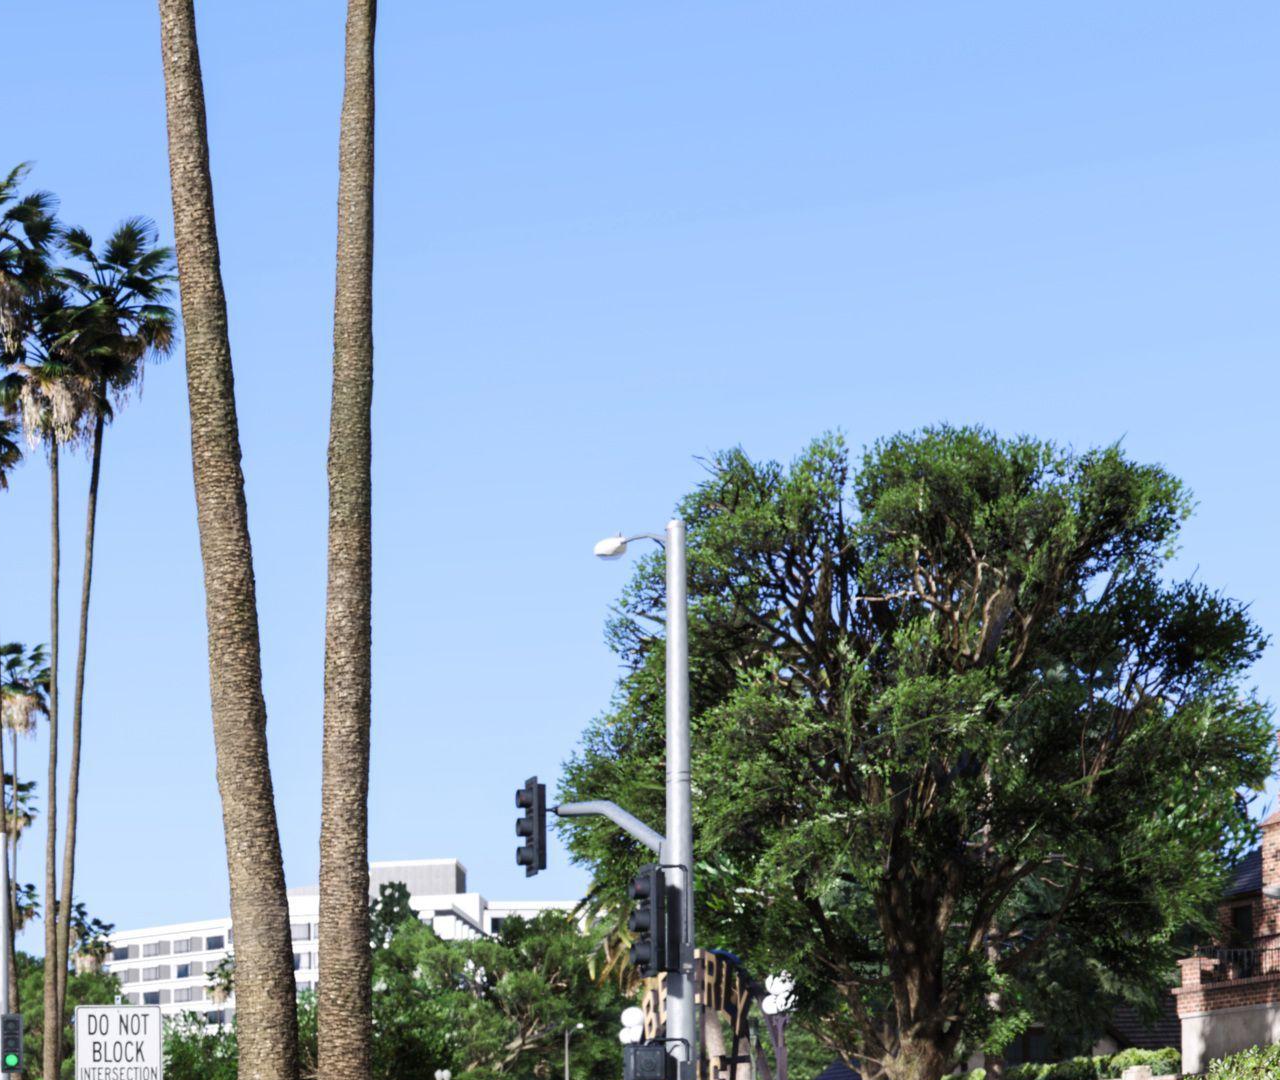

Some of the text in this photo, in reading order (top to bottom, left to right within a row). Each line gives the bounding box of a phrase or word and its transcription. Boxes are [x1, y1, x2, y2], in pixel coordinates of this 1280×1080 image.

[642, 948, 749, 1041] BERLY
[88, 1013, 149, 1036] DO NOT
[92, 1041, 145, 1063] BLOCK
